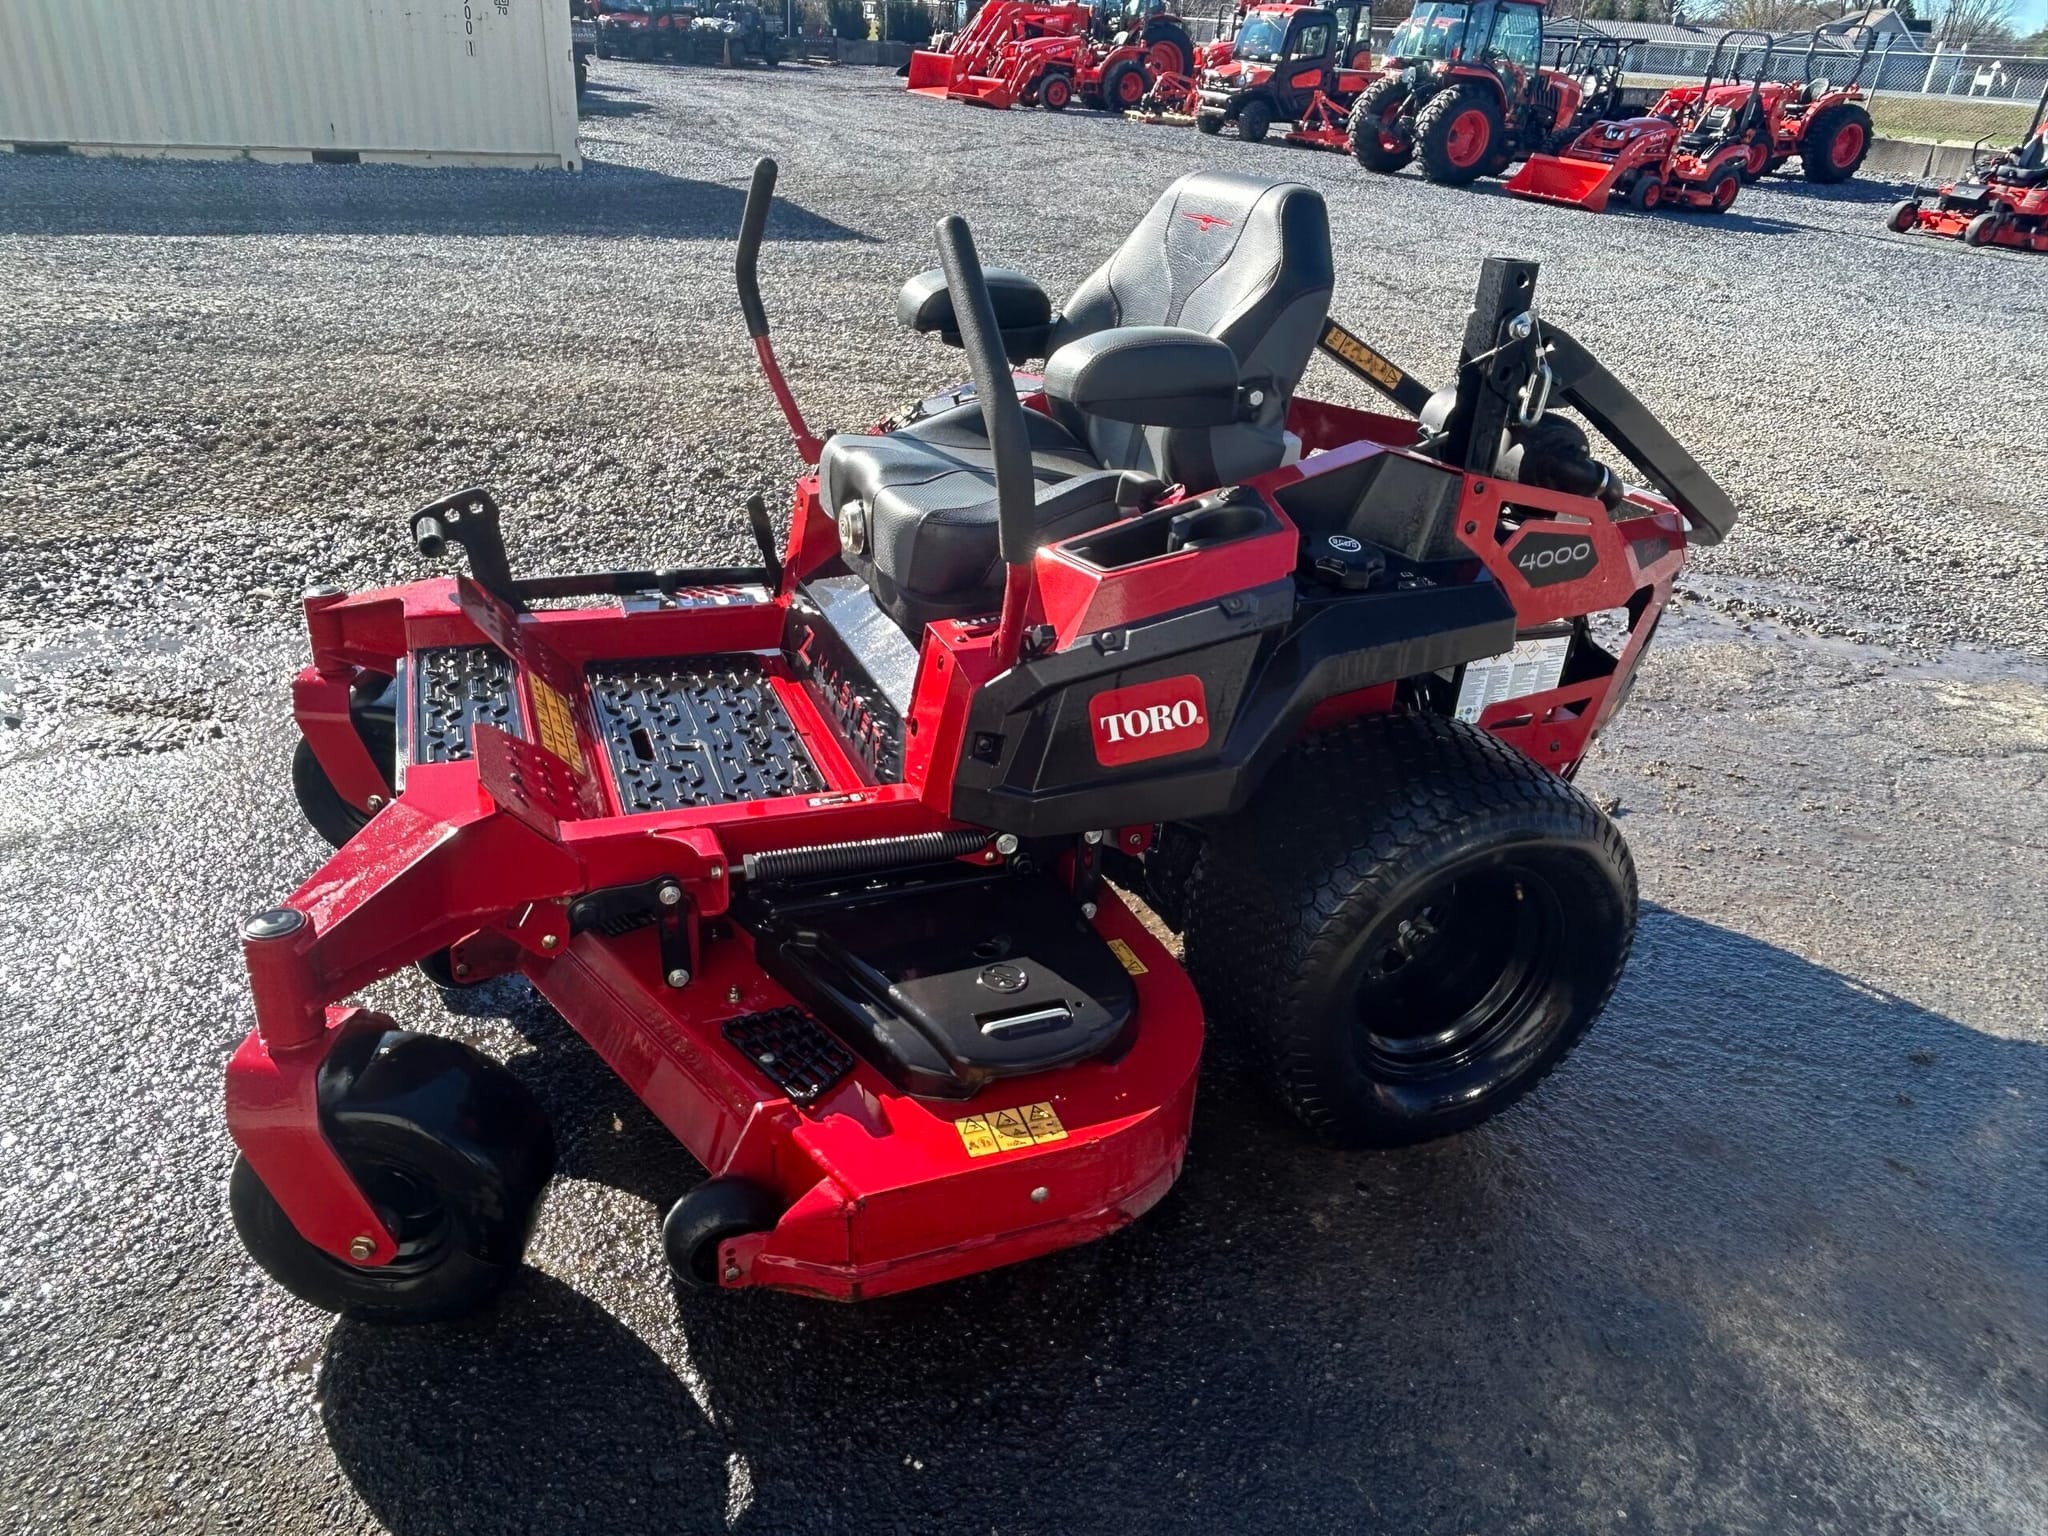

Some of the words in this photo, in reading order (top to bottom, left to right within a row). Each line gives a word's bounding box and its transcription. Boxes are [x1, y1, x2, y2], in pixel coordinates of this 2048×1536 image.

[497, 6, 507, 15] 70
[1519, 543, 1590, 570] 4000
[1100, 699, 1198, 743] TORO
